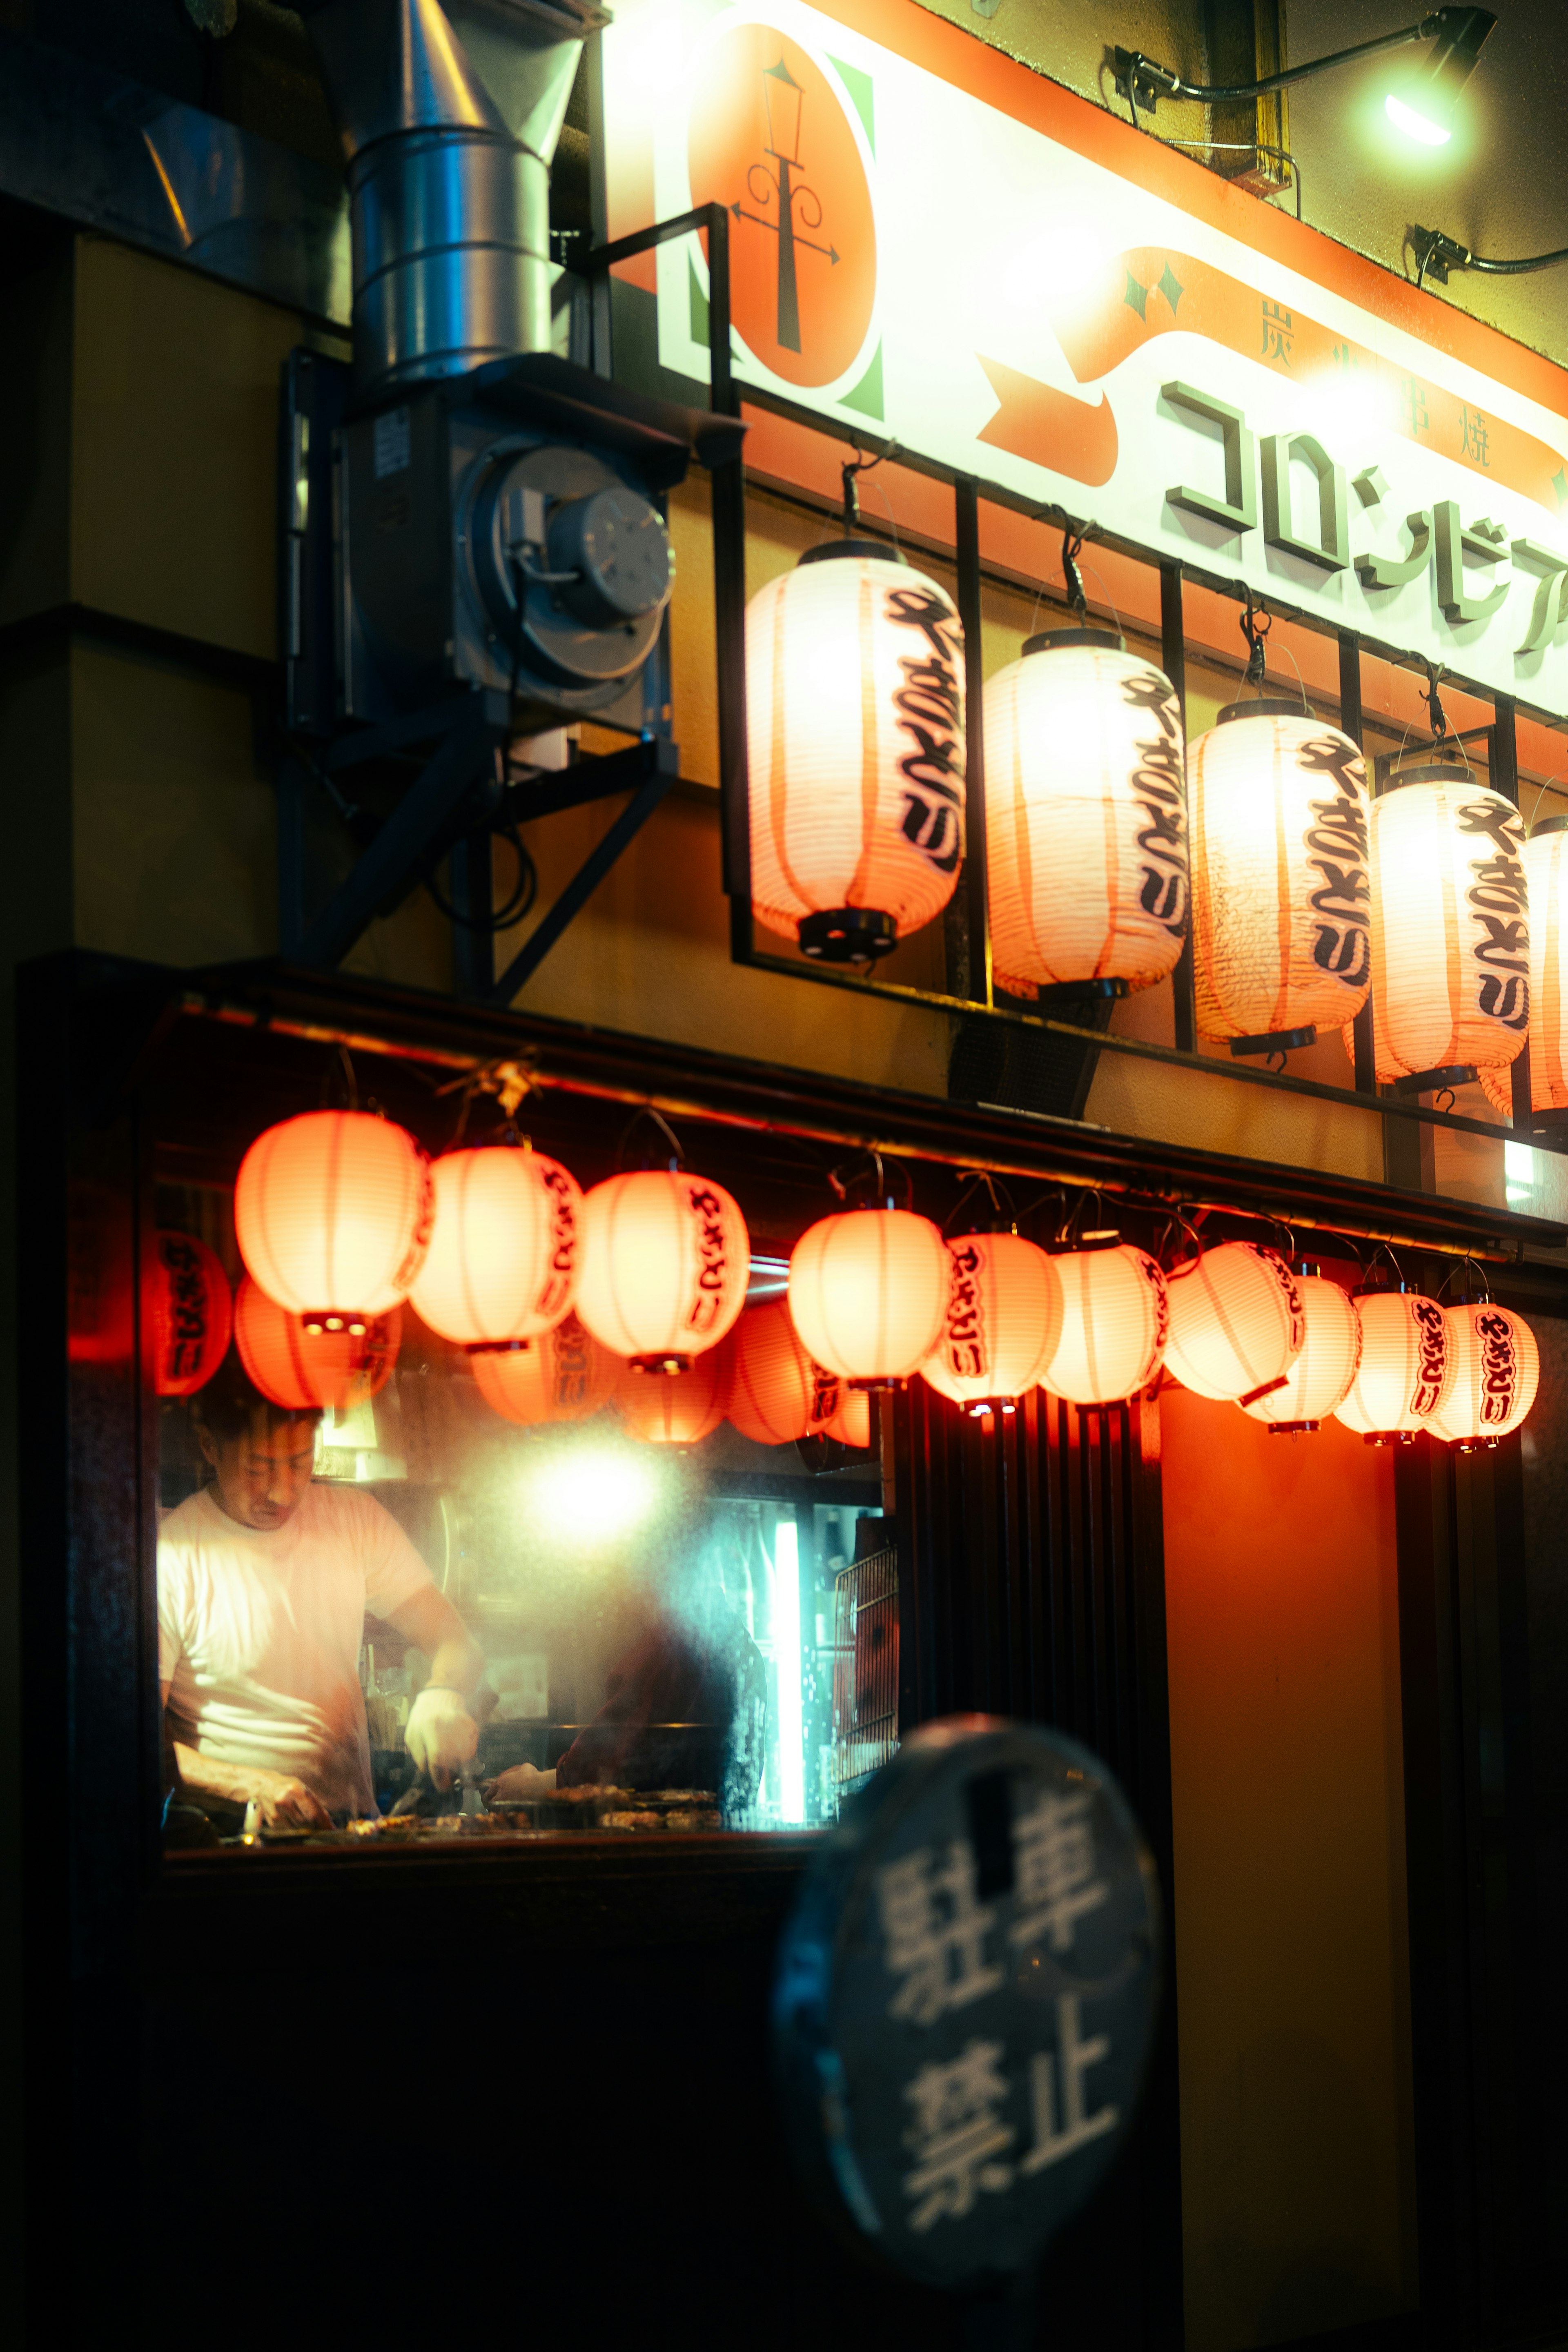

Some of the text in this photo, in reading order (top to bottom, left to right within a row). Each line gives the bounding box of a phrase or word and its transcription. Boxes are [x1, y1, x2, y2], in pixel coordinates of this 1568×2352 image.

[888, 585, 964, 874] やきとり
[1122, 670, 1188, 939] やきとり
[1300, 735, 1369, 986] やきとり
[1459, 797, 1529, 1030] やきとり
[688, 1184, 726, 1330] やきとり
[1414, 1301, 1446, 1414] やきとり
[1479, 1312, 1513, 1423] やきとり
[875, 1792, 1111, 2026] 駐車
[902, 1993, 1119, 2233] 禁止
